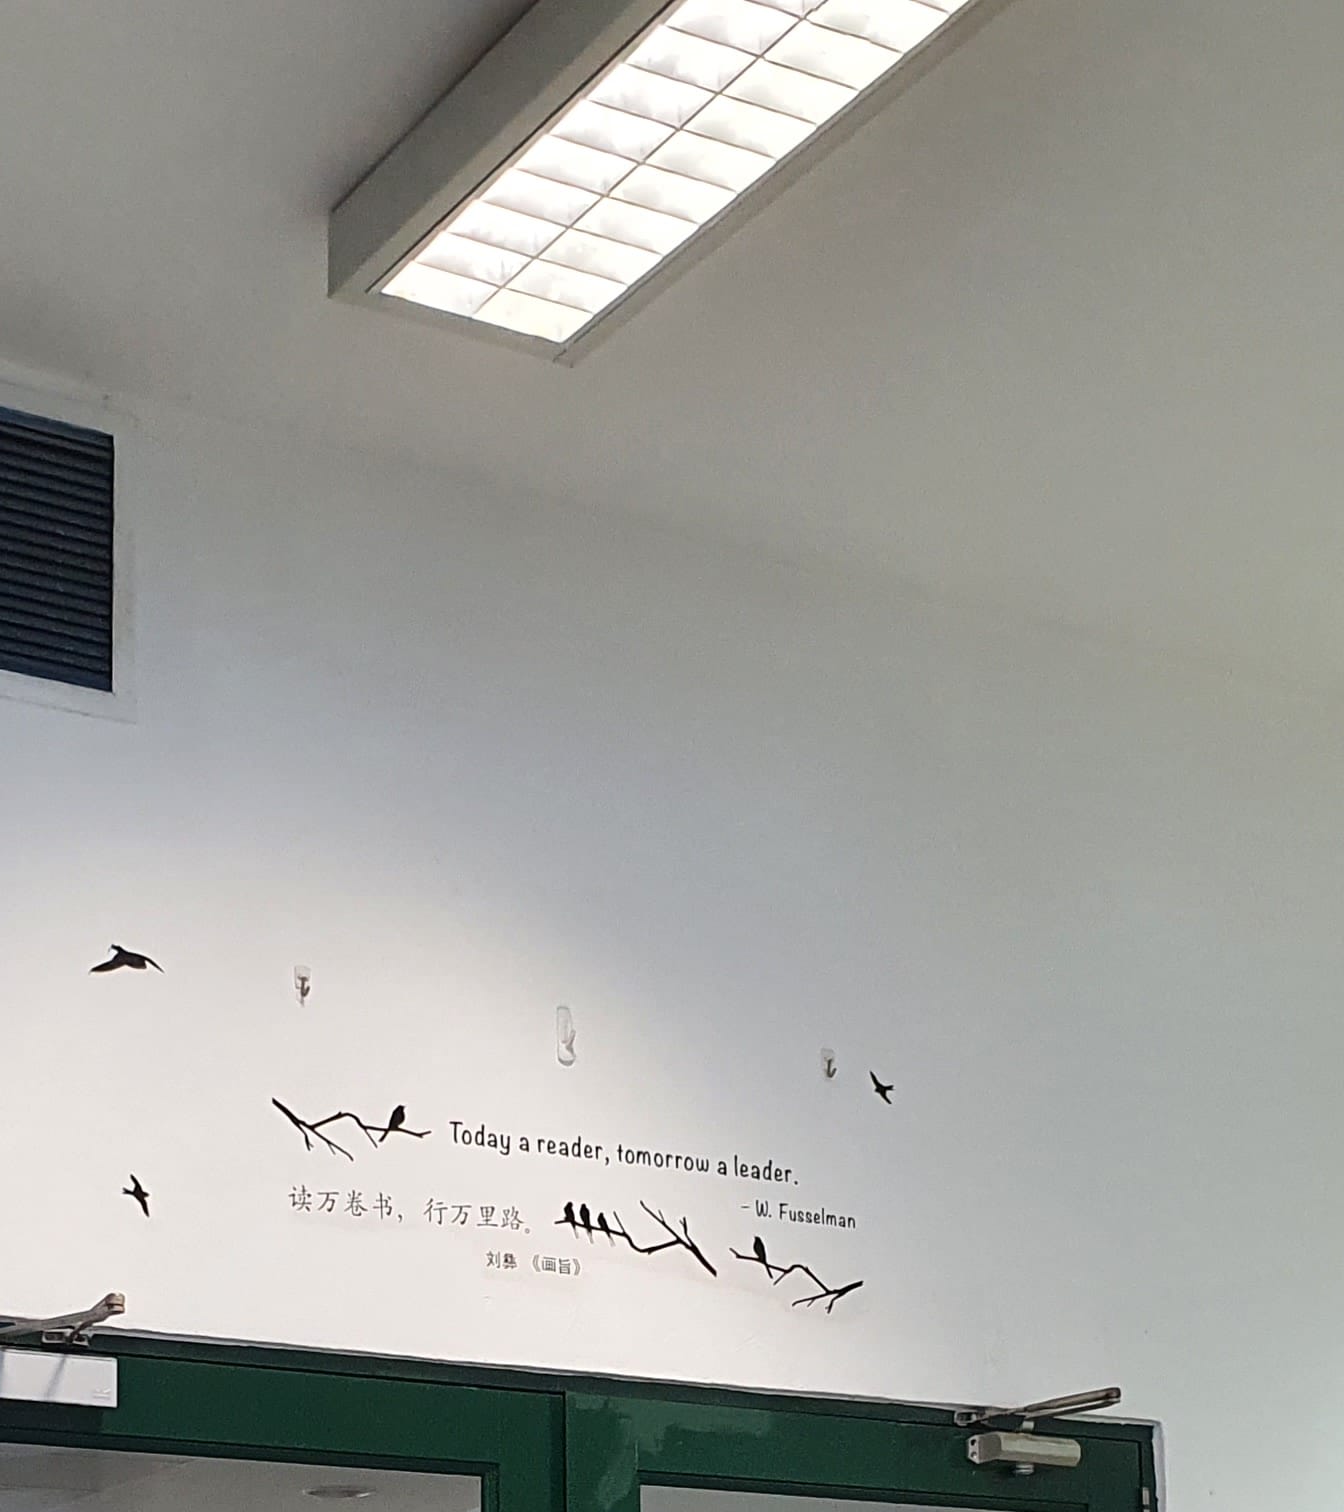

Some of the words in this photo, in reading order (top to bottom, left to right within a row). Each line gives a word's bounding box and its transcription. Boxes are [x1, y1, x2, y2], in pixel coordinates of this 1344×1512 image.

[448, 1120, 511, 1155] Today
[519, 1137, 529, 1153] a
[537, 1136, 610, 1166] reader,
[616, 1144, 710, 1174] tomorrow
[717, 1161, 728, 1177] a
[733, 1155, 800, 1186] leader.
[755, 1201, 773, 1220] W.
[779, 1203, 857, 1230] Fusselman
